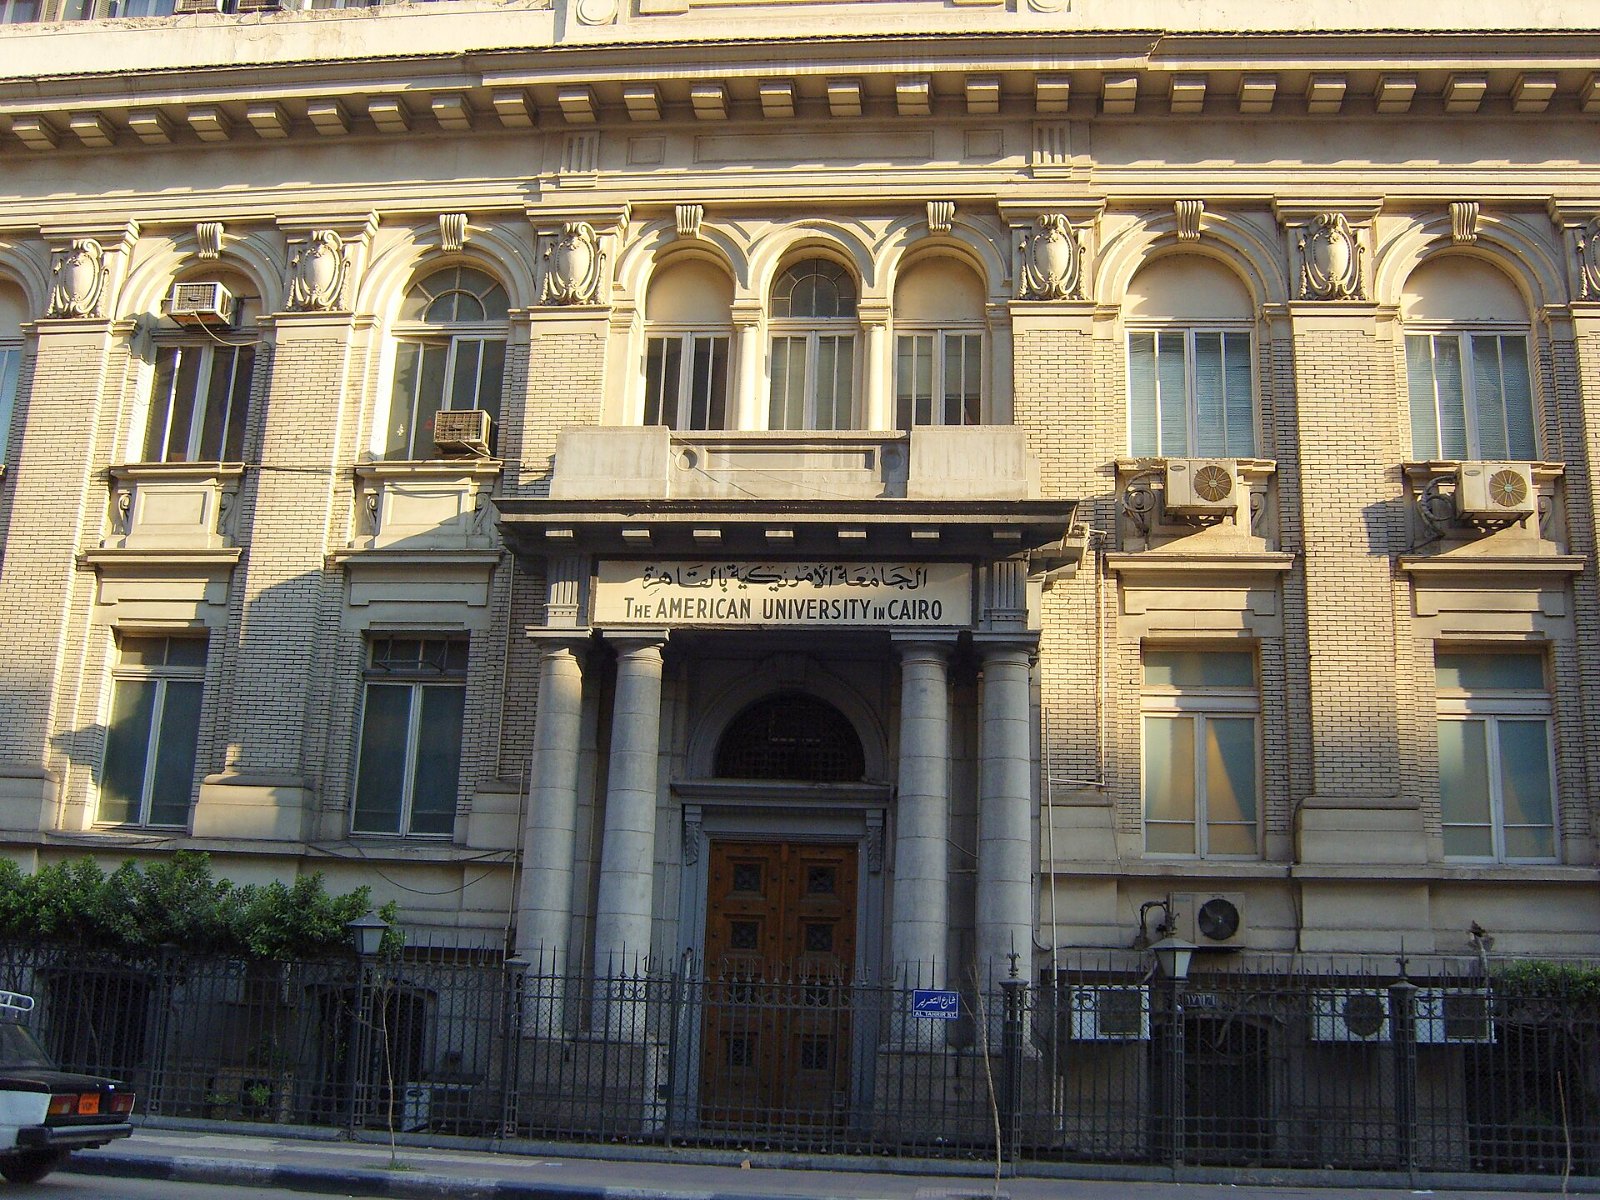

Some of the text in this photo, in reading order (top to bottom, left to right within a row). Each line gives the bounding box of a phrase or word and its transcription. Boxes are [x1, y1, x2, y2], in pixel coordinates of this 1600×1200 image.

[642, 564, 728, 593] بالقاهرة
[833, 564, 928, 591] الجامعة
[655, 598, 751, 619] AMERICAN
[762, 599, 871, 620] UNIVERSITY
[873, 606, 885, 620] IN
[887, 599, 943, 621] CAIRO
[941, 995, 956, 1009] شارع
